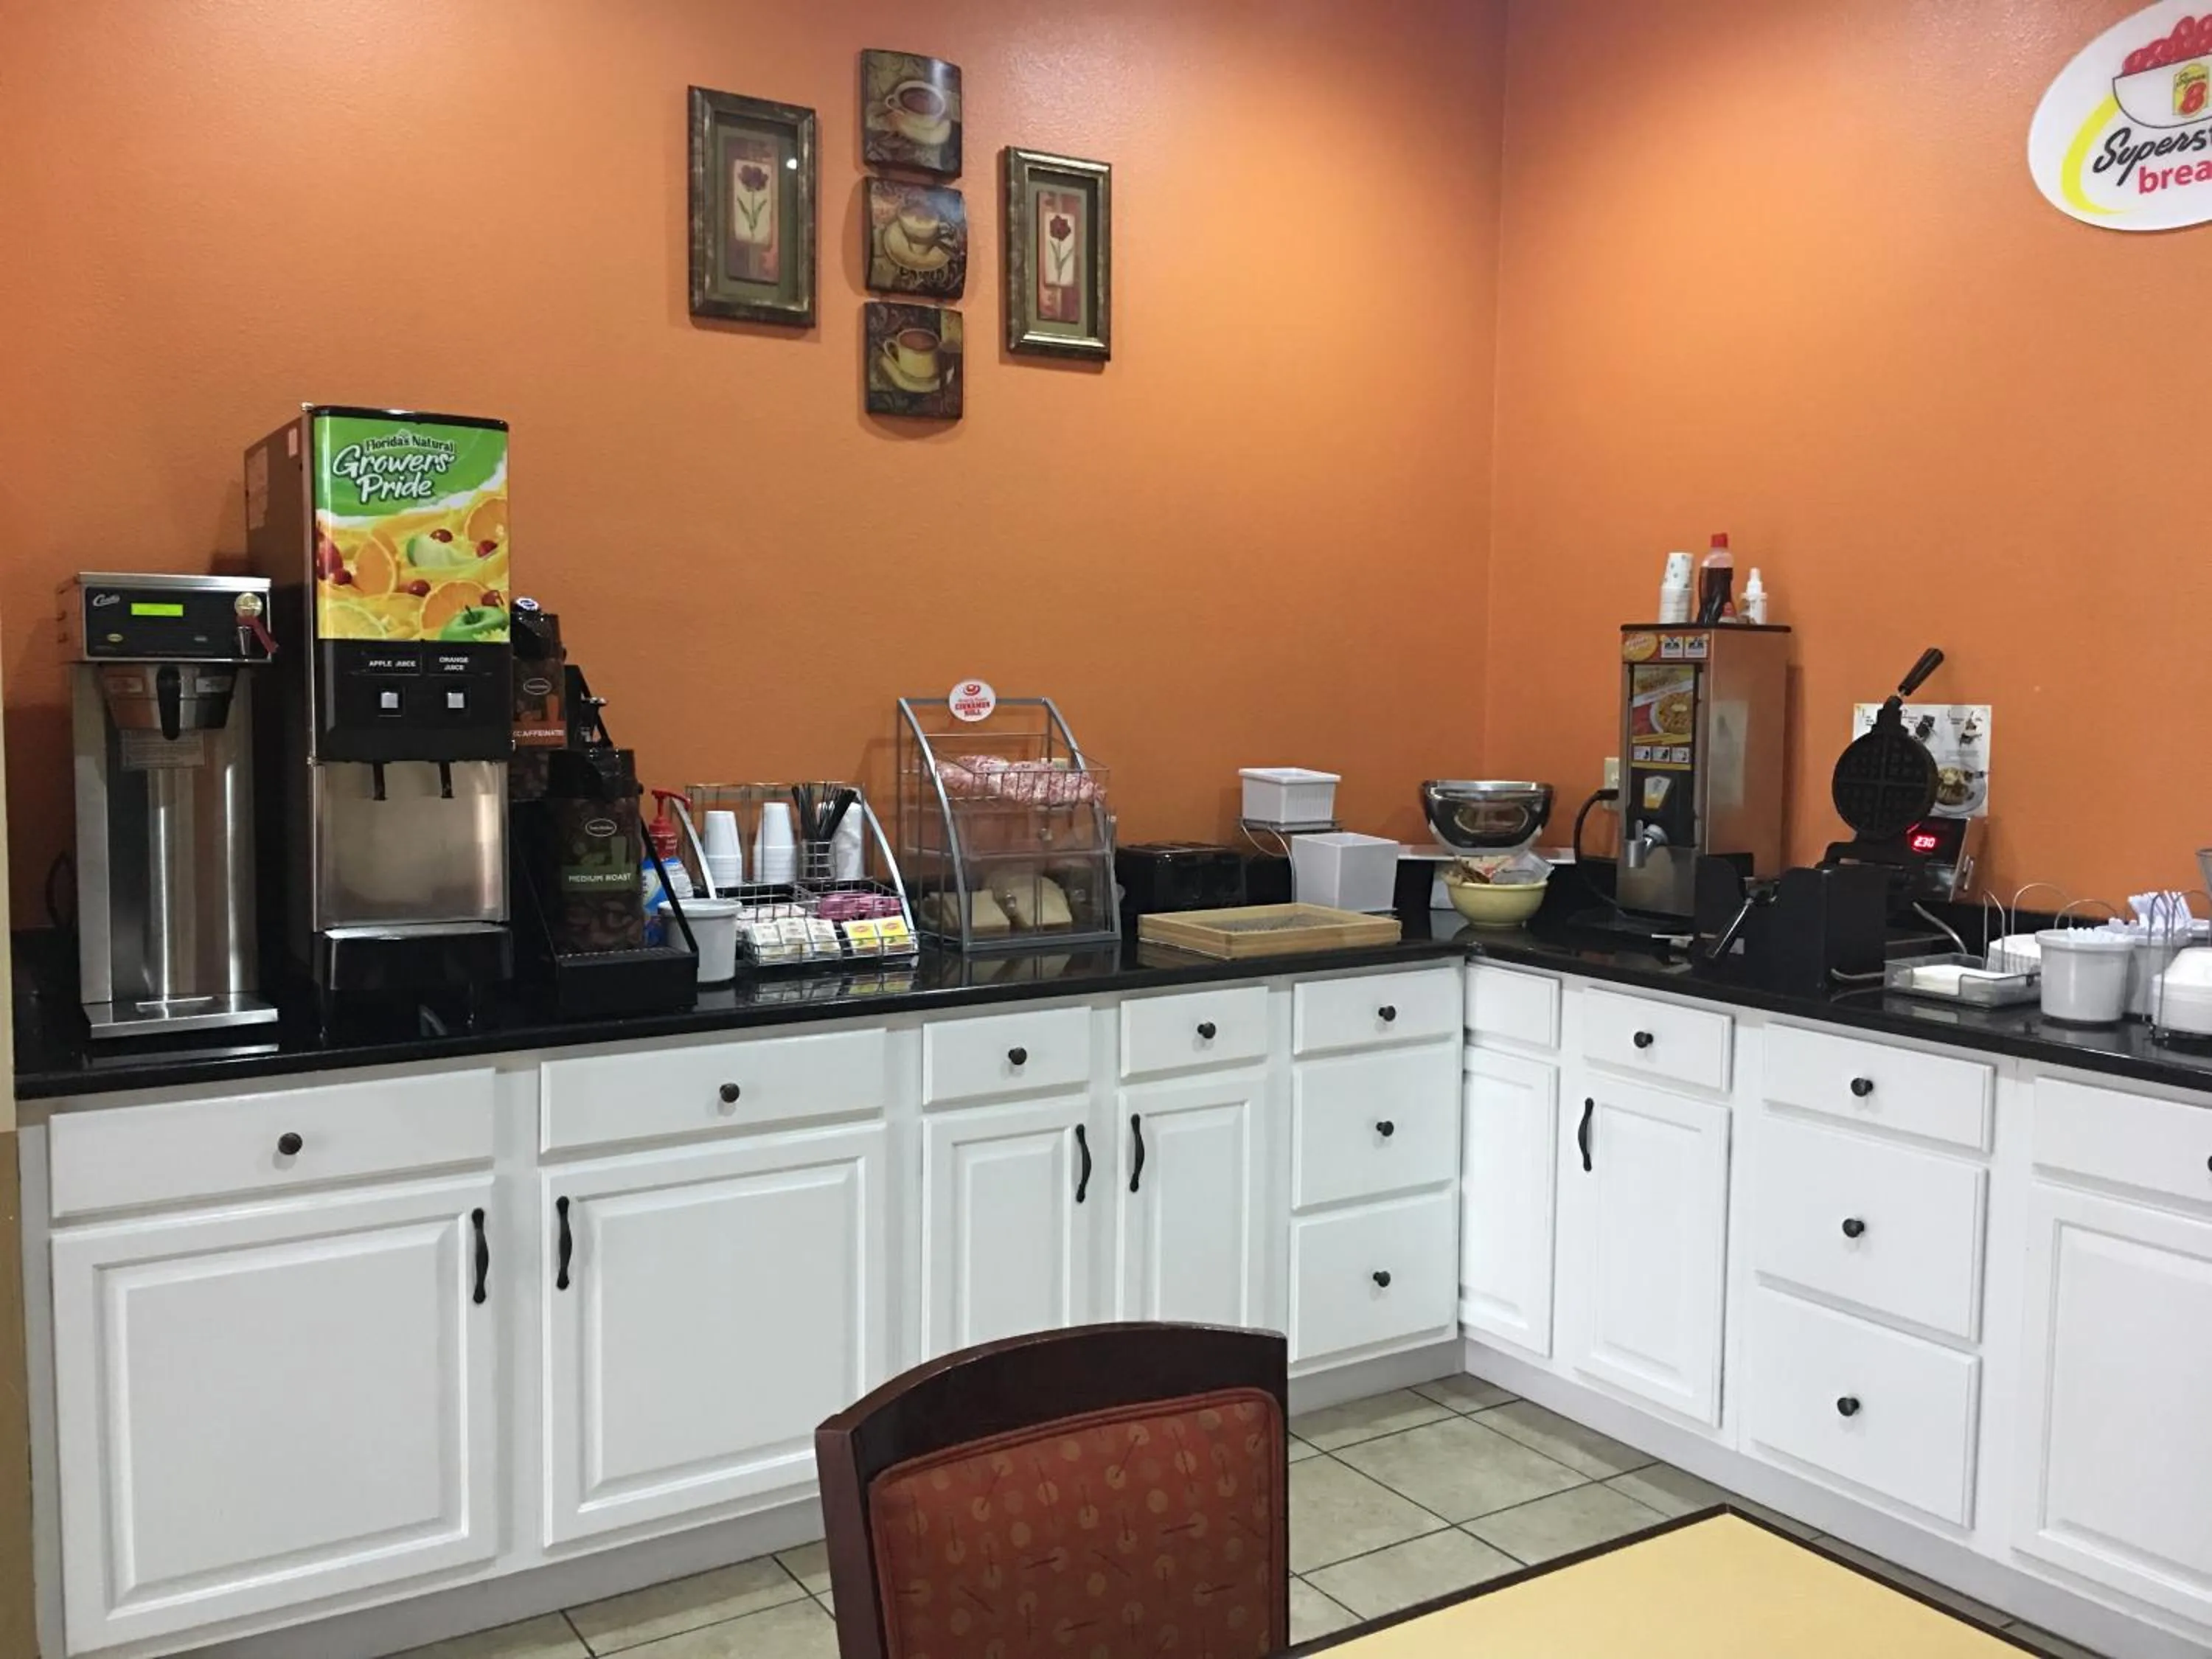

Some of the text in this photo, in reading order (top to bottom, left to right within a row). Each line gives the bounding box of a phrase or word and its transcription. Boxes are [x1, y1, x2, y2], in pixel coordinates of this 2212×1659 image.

[2093, 125, 2212, 186] Supers
[366, 435, 454, 453] Florida's Natural
[355, 472, 433, 504] Pride
[1913, 835, 1936, 848] 230
[568, 873, 632, 883] MEDIUM ROAST
